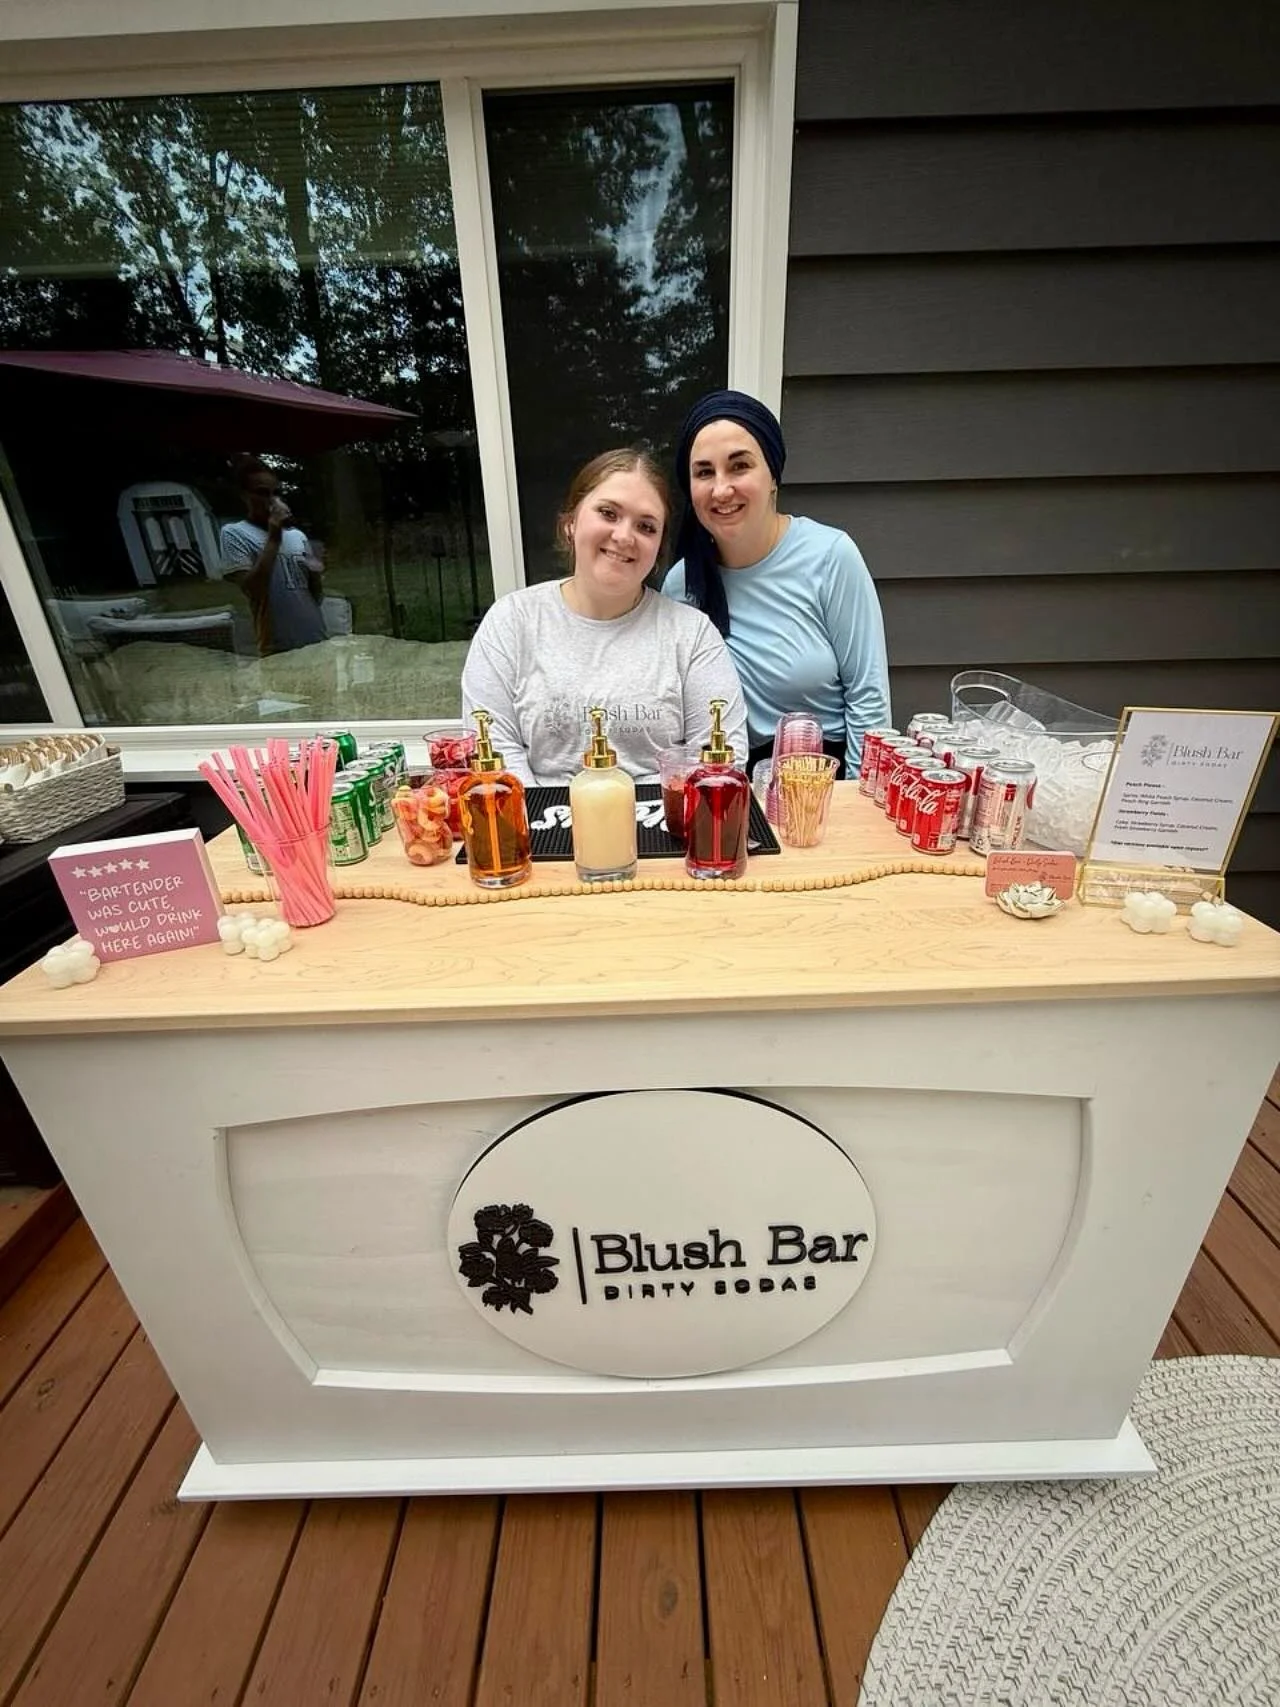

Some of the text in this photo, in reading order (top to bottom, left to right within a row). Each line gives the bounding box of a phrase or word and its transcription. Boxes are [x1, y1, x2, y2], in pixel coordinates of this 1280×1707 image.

[635, 704, 662, 720] Bar
[1173, 745, 1243, 760] Blush Bar
[79, 875, 184, 902] "BARTENDER
[87, 895, 175, 921] WAS CUTE,
[156, 908, 203, 926] DRINK
[101, 925, 200, 954] HERE AGAIN!"
[590, 1225, 869, 1274] Blush Bar
[604, 1275, 817, 1301] DIRTY SODAS
